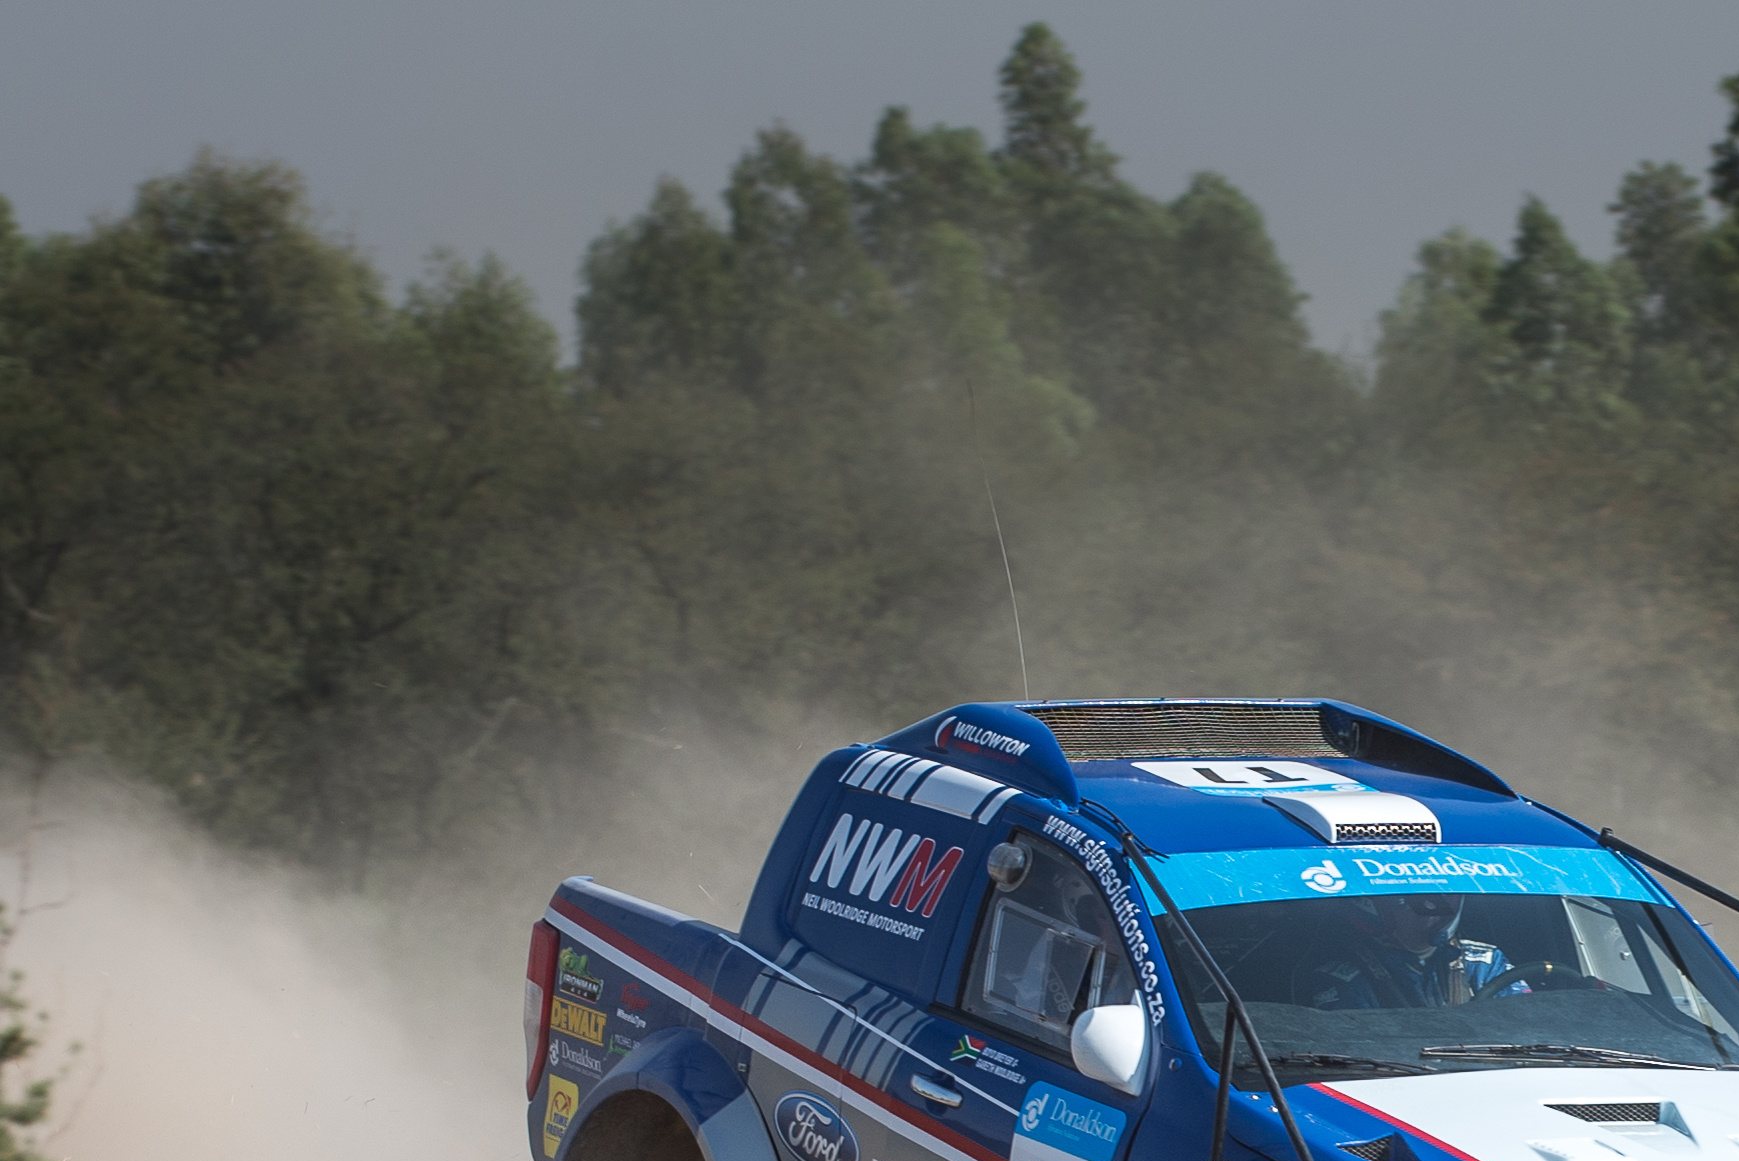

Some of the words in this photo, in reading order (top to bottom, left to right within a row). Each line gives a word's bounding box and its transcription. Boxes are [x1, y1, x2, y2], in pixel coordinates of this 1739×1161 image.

[954, 721, 1030, 756] WILLOWTON
[809, 813, 964, 918] NWM
[1352, 856, 1513, 877] Donaldson
[802, 892, 818, 908] NEIL
[820, 896, 869, 925] WOOLRIDGE
[867, 912, 925, 941] MOTORSPORT
[1042, 815, 1166, 1027] www.signsolutions.co.za
[561, 1041, 602, 1073] Donaldson
[1050, 1098, 1116, 1142] Donaldson
